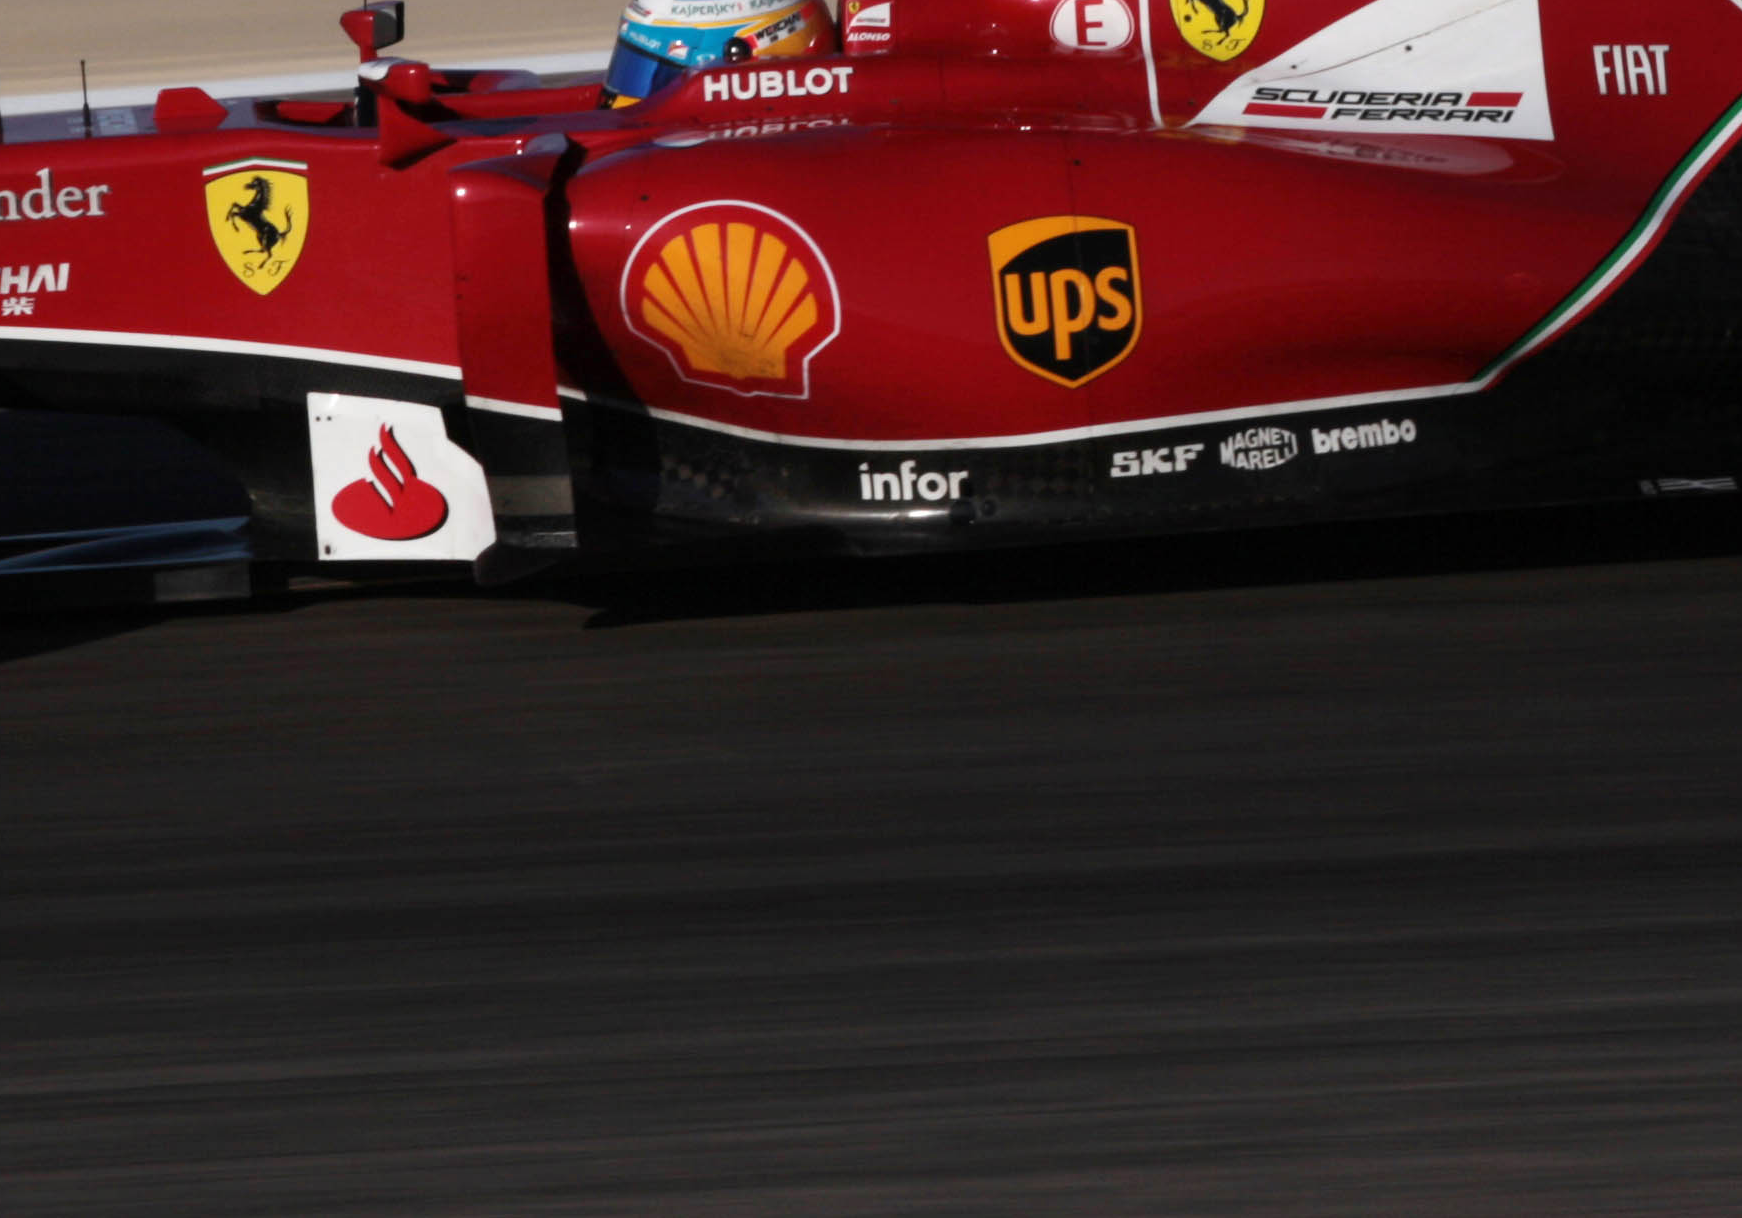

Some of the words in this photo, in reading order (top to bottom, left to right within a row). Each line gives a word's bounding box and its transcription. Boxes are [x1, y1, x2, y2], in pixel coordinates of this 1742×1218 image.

[846, 32, 891, 43] ALONSO
[703, 67, 854, 102] HUBLOT
[1593, 45, 1670, 94] FIAT
[1252, 87, 1463, 107] SCUDERIA
[1331, 108, 1514, 124] FERRARI
[1004, 266, 1133, 361] ups
[1311, 418, 1417, 455] brembo
[1110, 443, 1205, 478] SKF
[860, 461, 969, 502] infor
